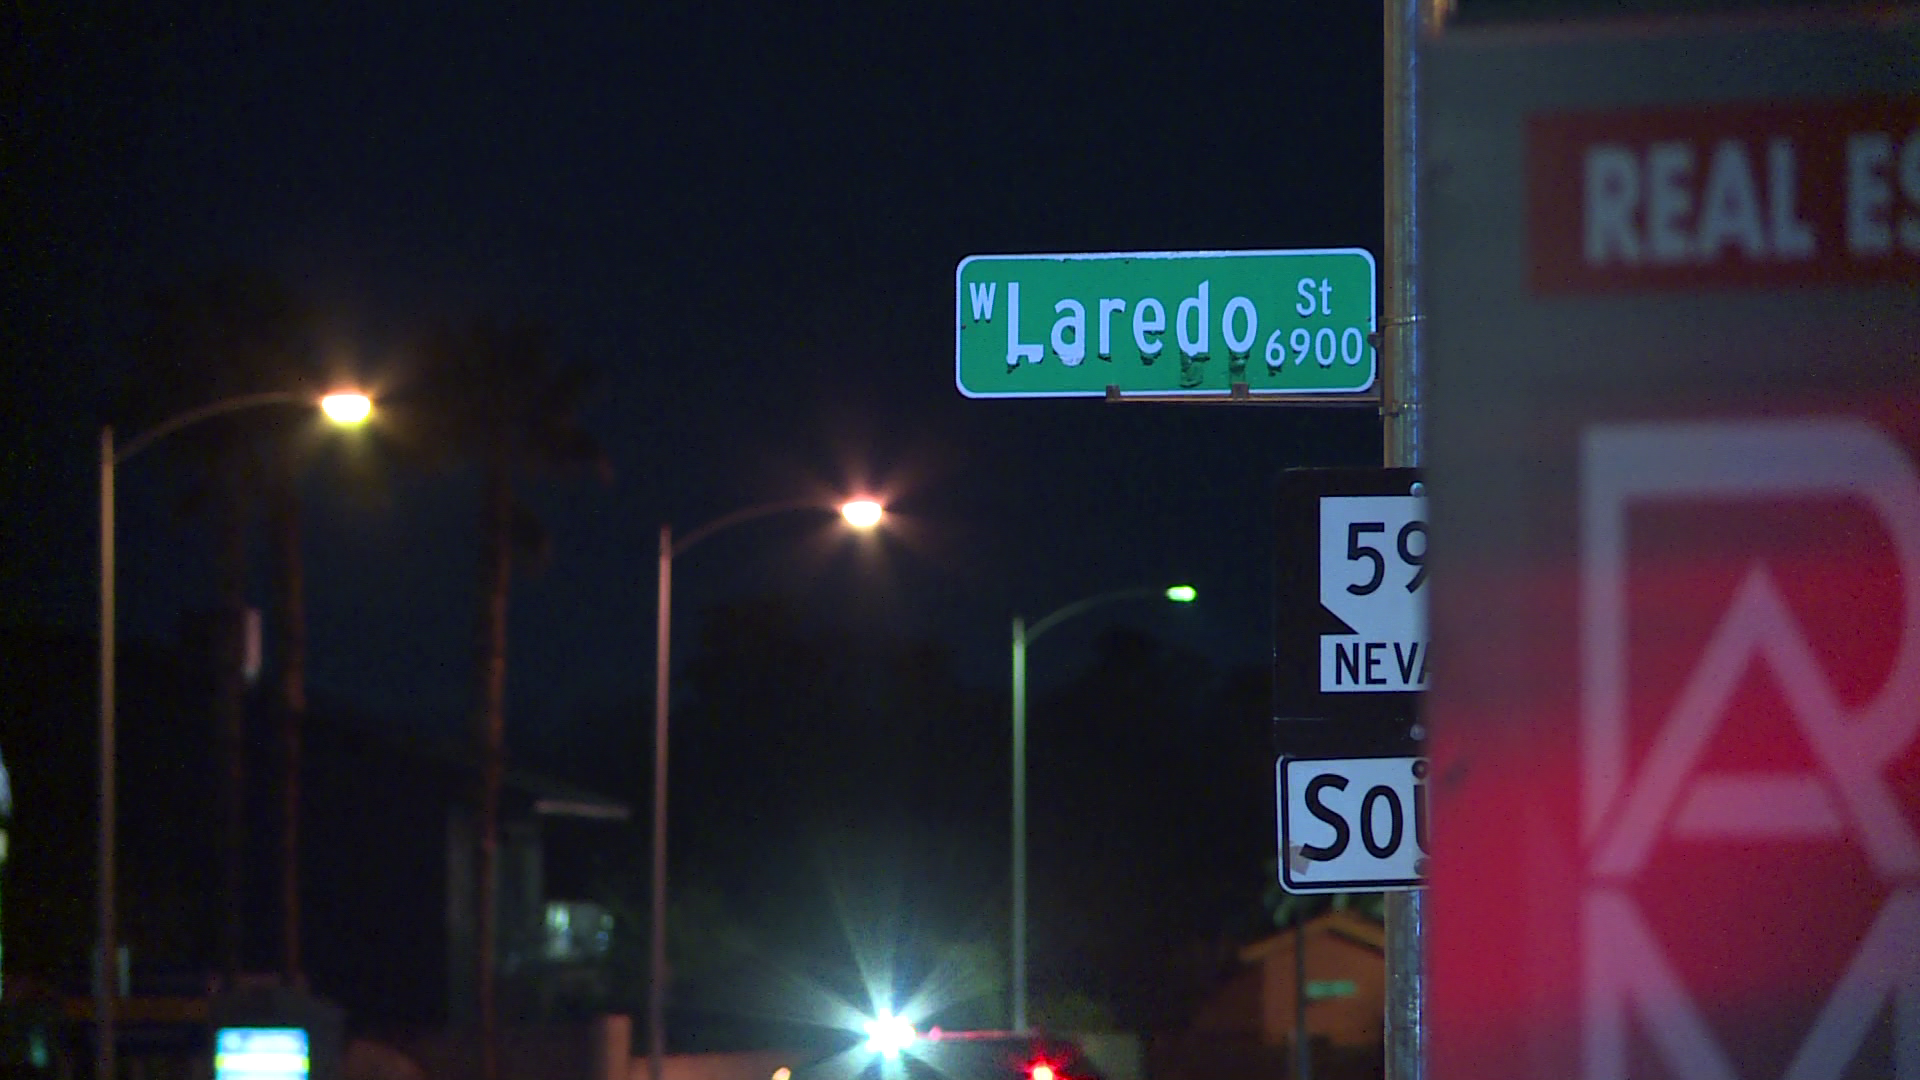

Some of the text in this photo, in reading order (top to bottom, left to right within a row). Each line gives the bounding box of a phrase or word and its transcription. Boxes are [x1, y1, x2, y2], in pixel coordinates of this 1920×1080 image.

[1586, 138, 1814, 264] REAL
[969, 280, 1258, 366] W Laredo
[1295, 277, 1332, 317] St
[1264, 326, 1363, 367] 6900
